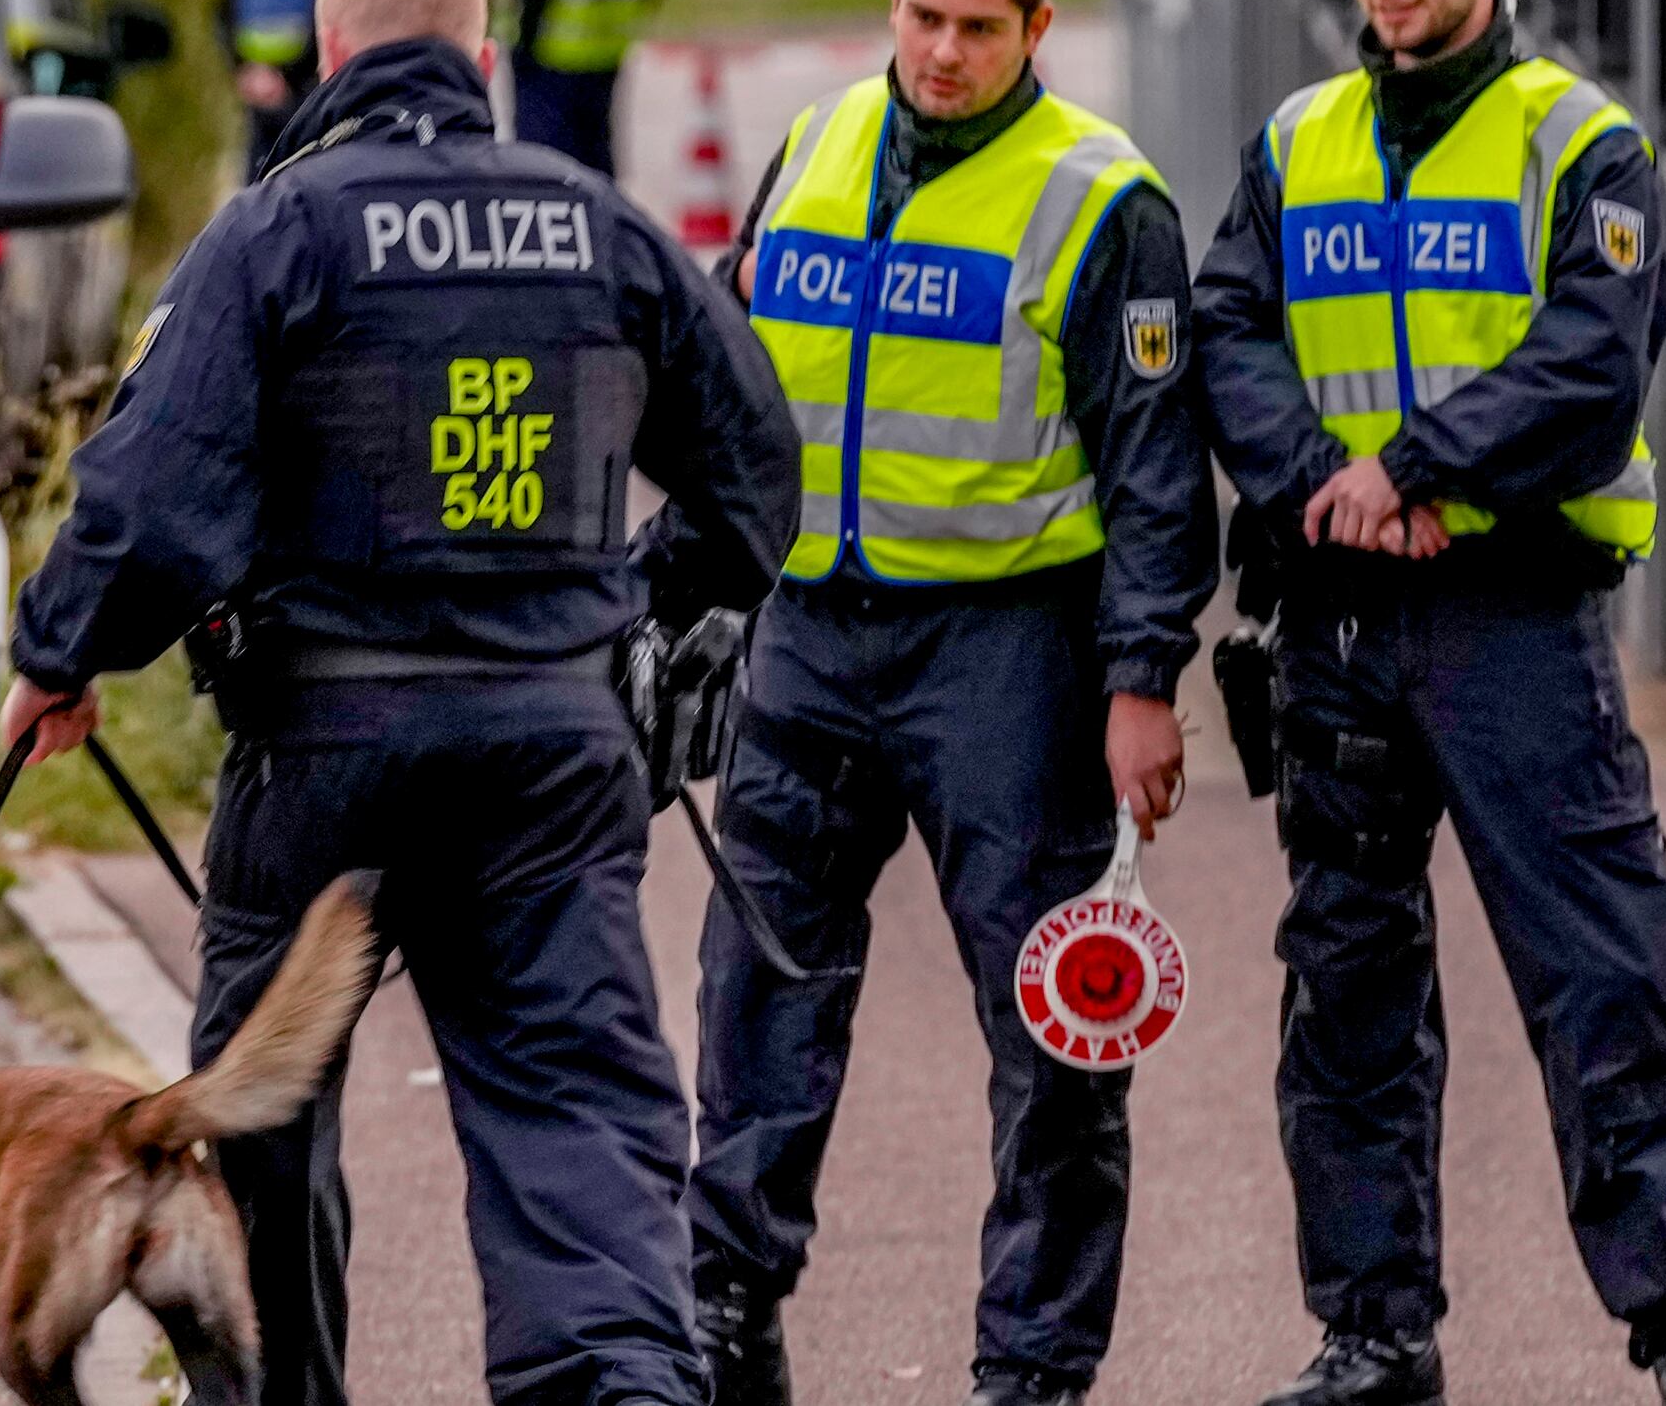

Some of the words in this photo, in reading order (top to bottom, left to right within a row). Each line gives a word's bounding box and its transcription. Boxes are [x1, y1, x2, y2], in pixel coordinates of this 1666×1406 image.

[362, 198, 594, 272] POLIZEI
[1303, 221, 1488, 276] POLIZEI
[774, 248, 959, 318] POLIZEI
[447, 357, 534, 415] BP
[430, 413, 554, 474] DHF
[440, 470, 544, 531] 540
[1020, 898, 1183, 1013] BUNDESPOLIZEI
[1030, 1012, 1142, 1066] HALT
